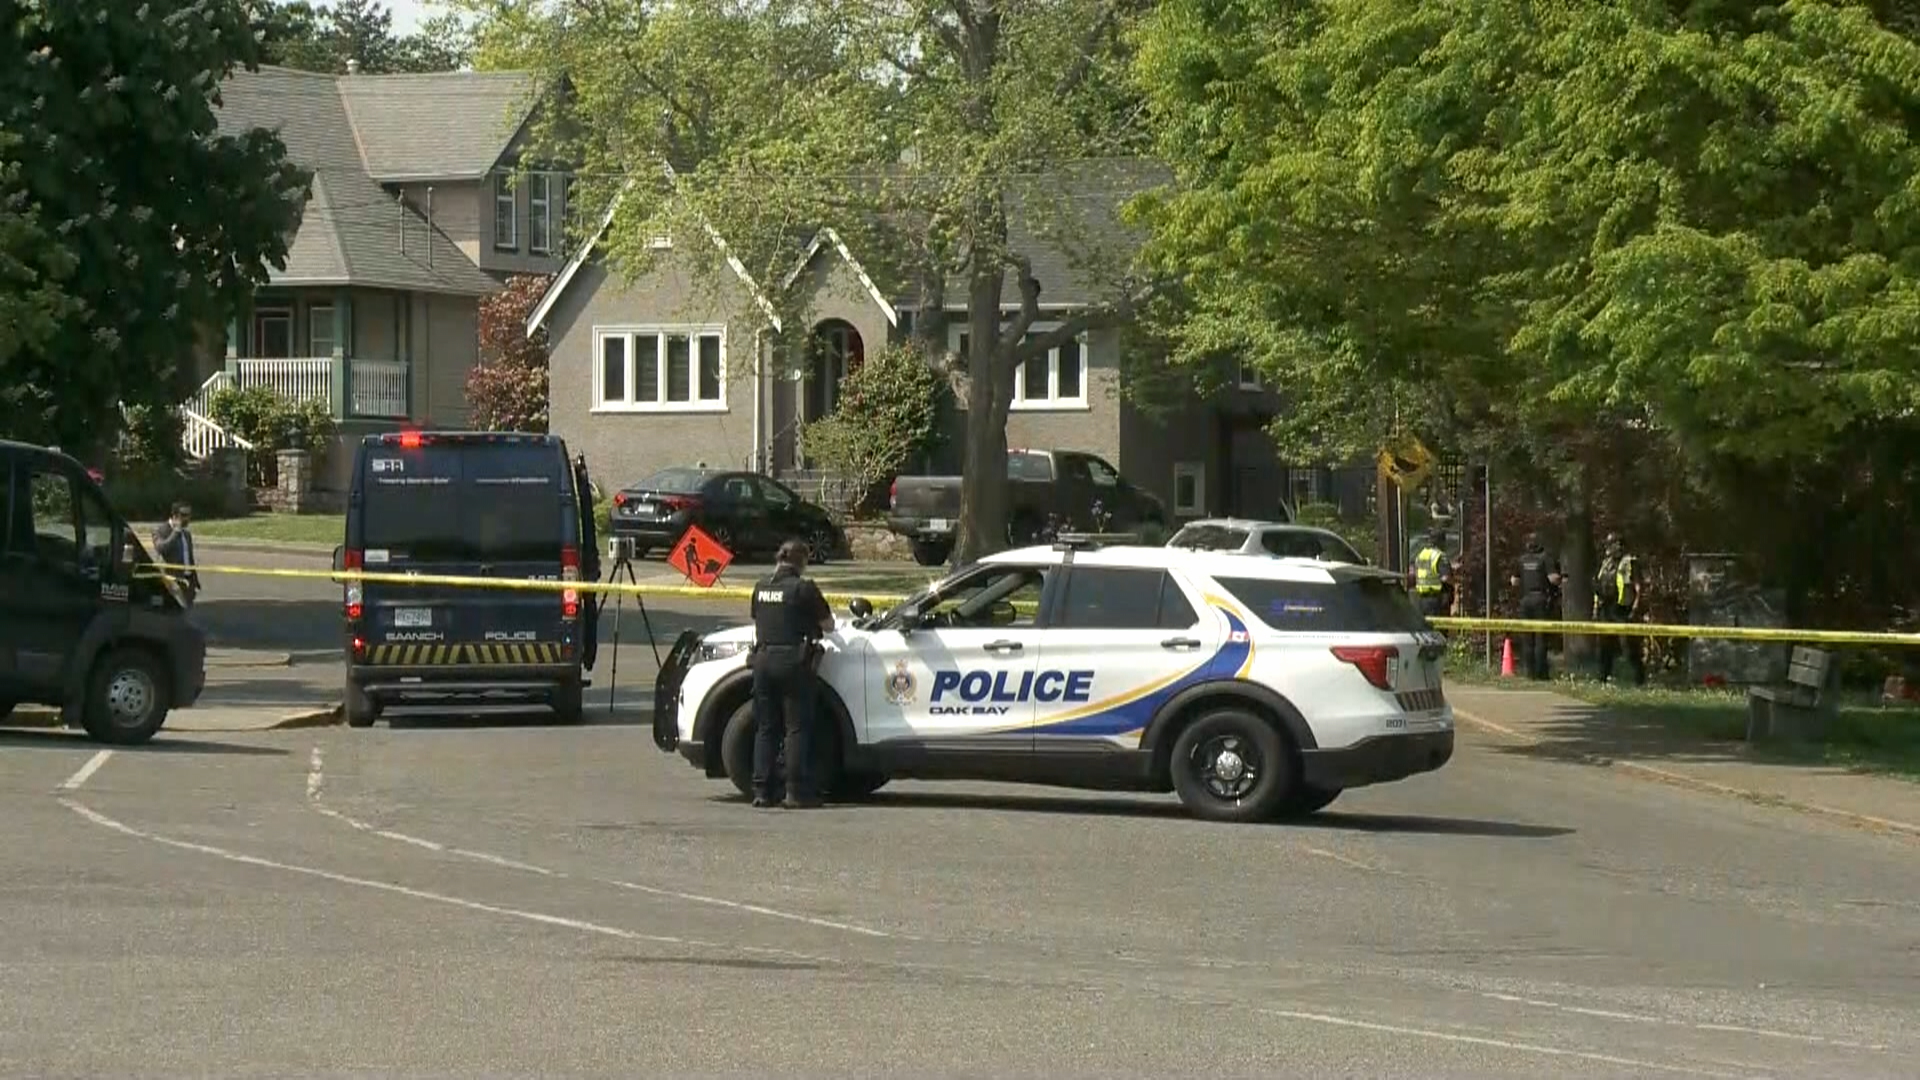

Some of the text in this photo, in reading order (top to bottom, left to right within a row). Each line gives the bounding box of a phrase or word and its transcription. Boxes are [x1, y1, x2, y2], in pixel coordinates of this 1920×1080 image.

[758, 590, 784, 602] POLICE
[385, 631, 537, 641] SAANICH POLICE
[930, 670, 1095, 702] POLICE
[929, 706, 1010, 715] OAK BAY
